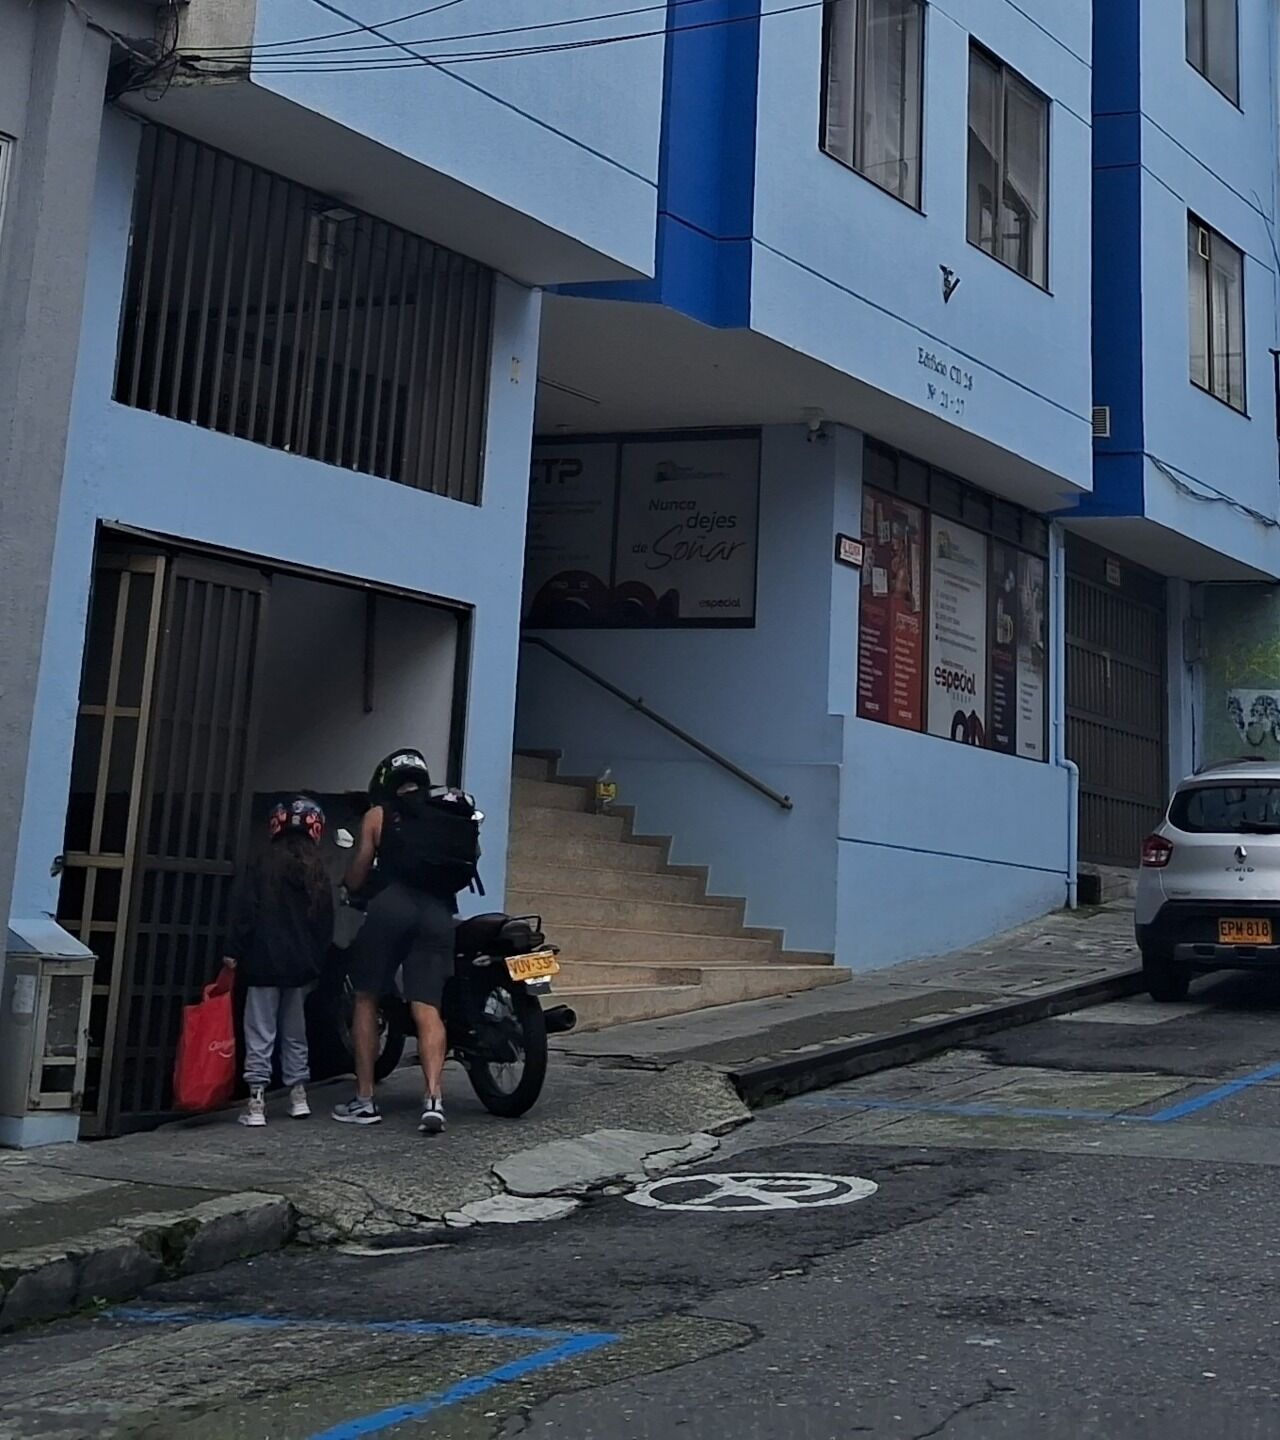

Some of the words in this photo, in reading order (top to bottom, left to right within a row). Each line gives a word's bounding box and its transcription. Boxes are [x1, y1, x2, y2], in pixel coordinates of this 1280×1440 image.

[918, 347, 947, 376] Edificio
[648, 498, 697, 511] Nunca
[686, 512, 737, 532] dejes
[632, 543, 648, 553] de
[645, 525, 746, 570] Soñar
[934, 666, 976, 697] especial
